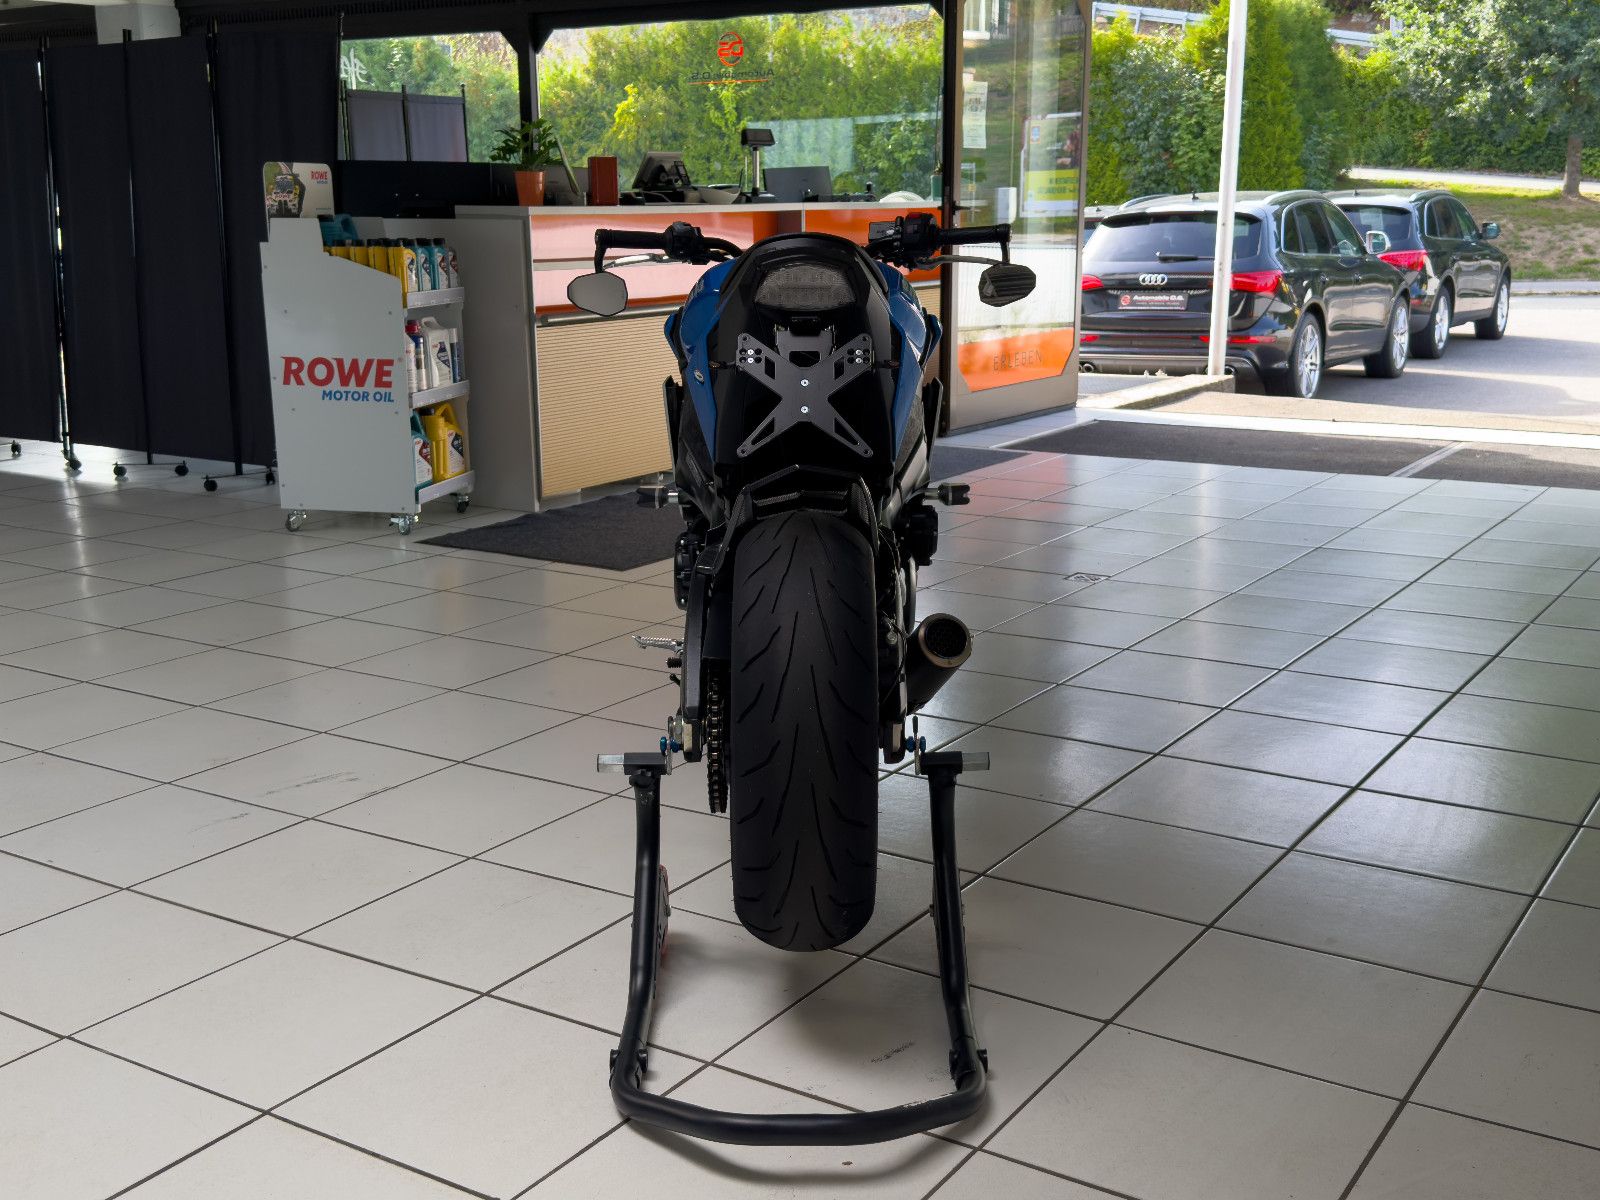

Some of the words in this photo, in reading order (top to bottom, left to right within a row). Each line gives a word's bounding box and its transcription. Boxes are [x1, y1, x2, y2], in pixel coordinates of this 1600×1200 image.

[311, 170, 328, 180] ROWE
[993, 350, 1042, 371] ERLEBEN
[281, 356, 395, 388] ROWE
[322, 389, 370, 402] MOTOR
[372, 391, 395, 403] OIL
